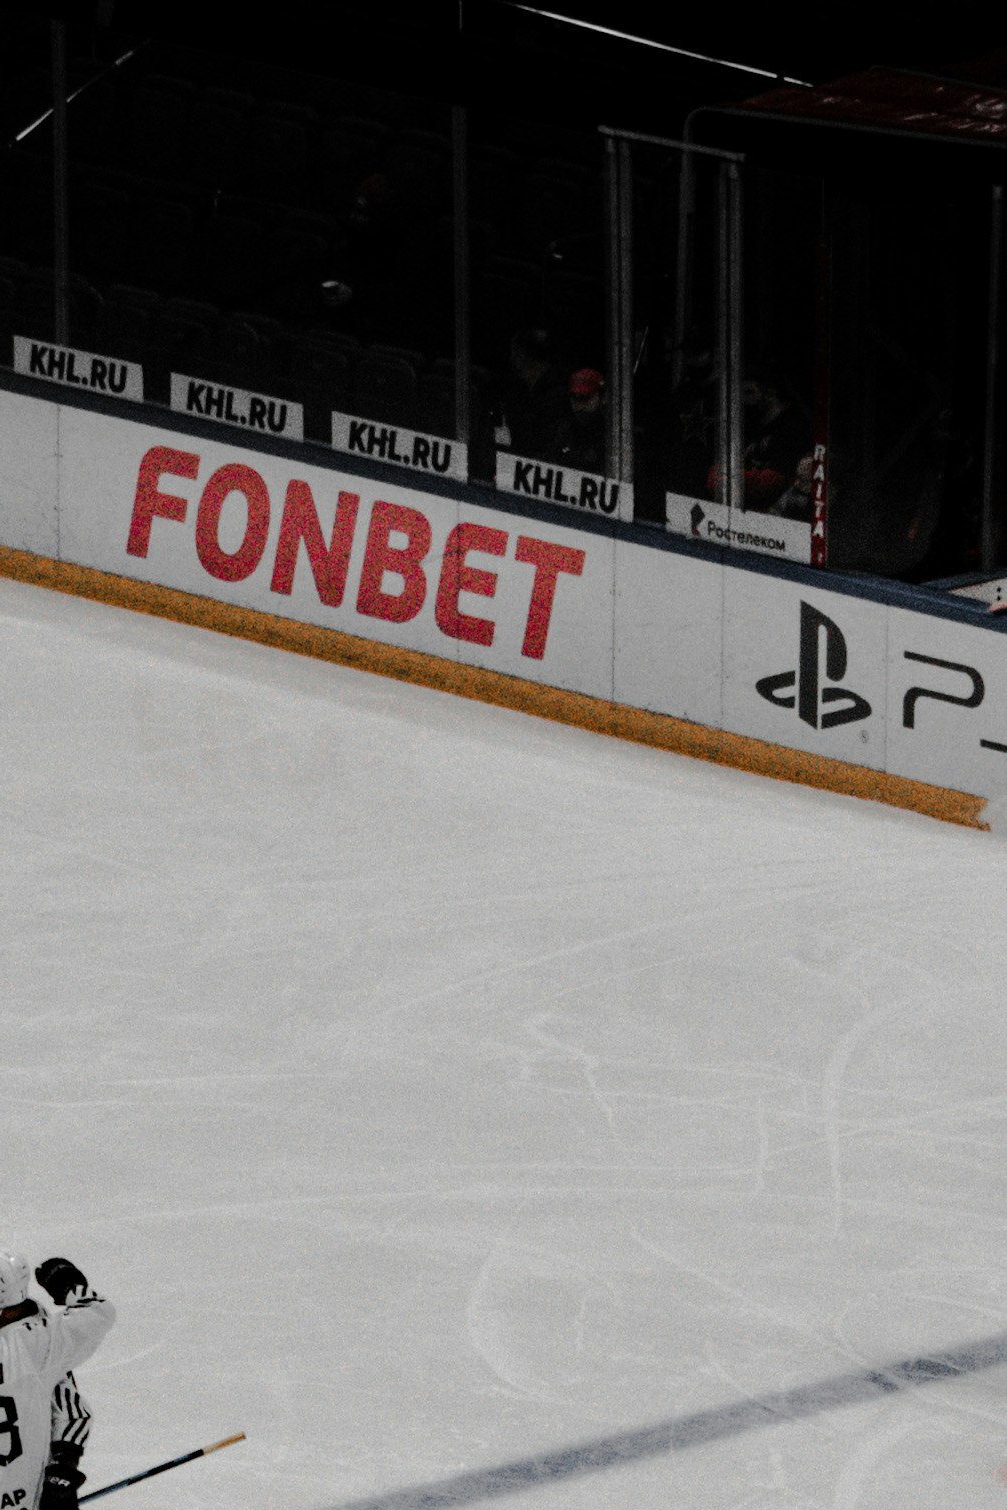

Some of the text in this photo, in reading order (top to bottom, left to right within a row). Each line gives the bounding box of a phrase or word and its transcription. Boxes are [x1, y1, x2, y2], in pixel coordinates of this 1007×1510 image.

[29, 344, 127, 394] KHL.RU
[186, 382, 287, 433] KHL.RU
[348, 421, 452, 474] KHL.RU
[512, 461, 620, 514] KHL.RU
[126, 444, 586, 661] FONBET
[707, 521, 786, 551] Ростелеком
